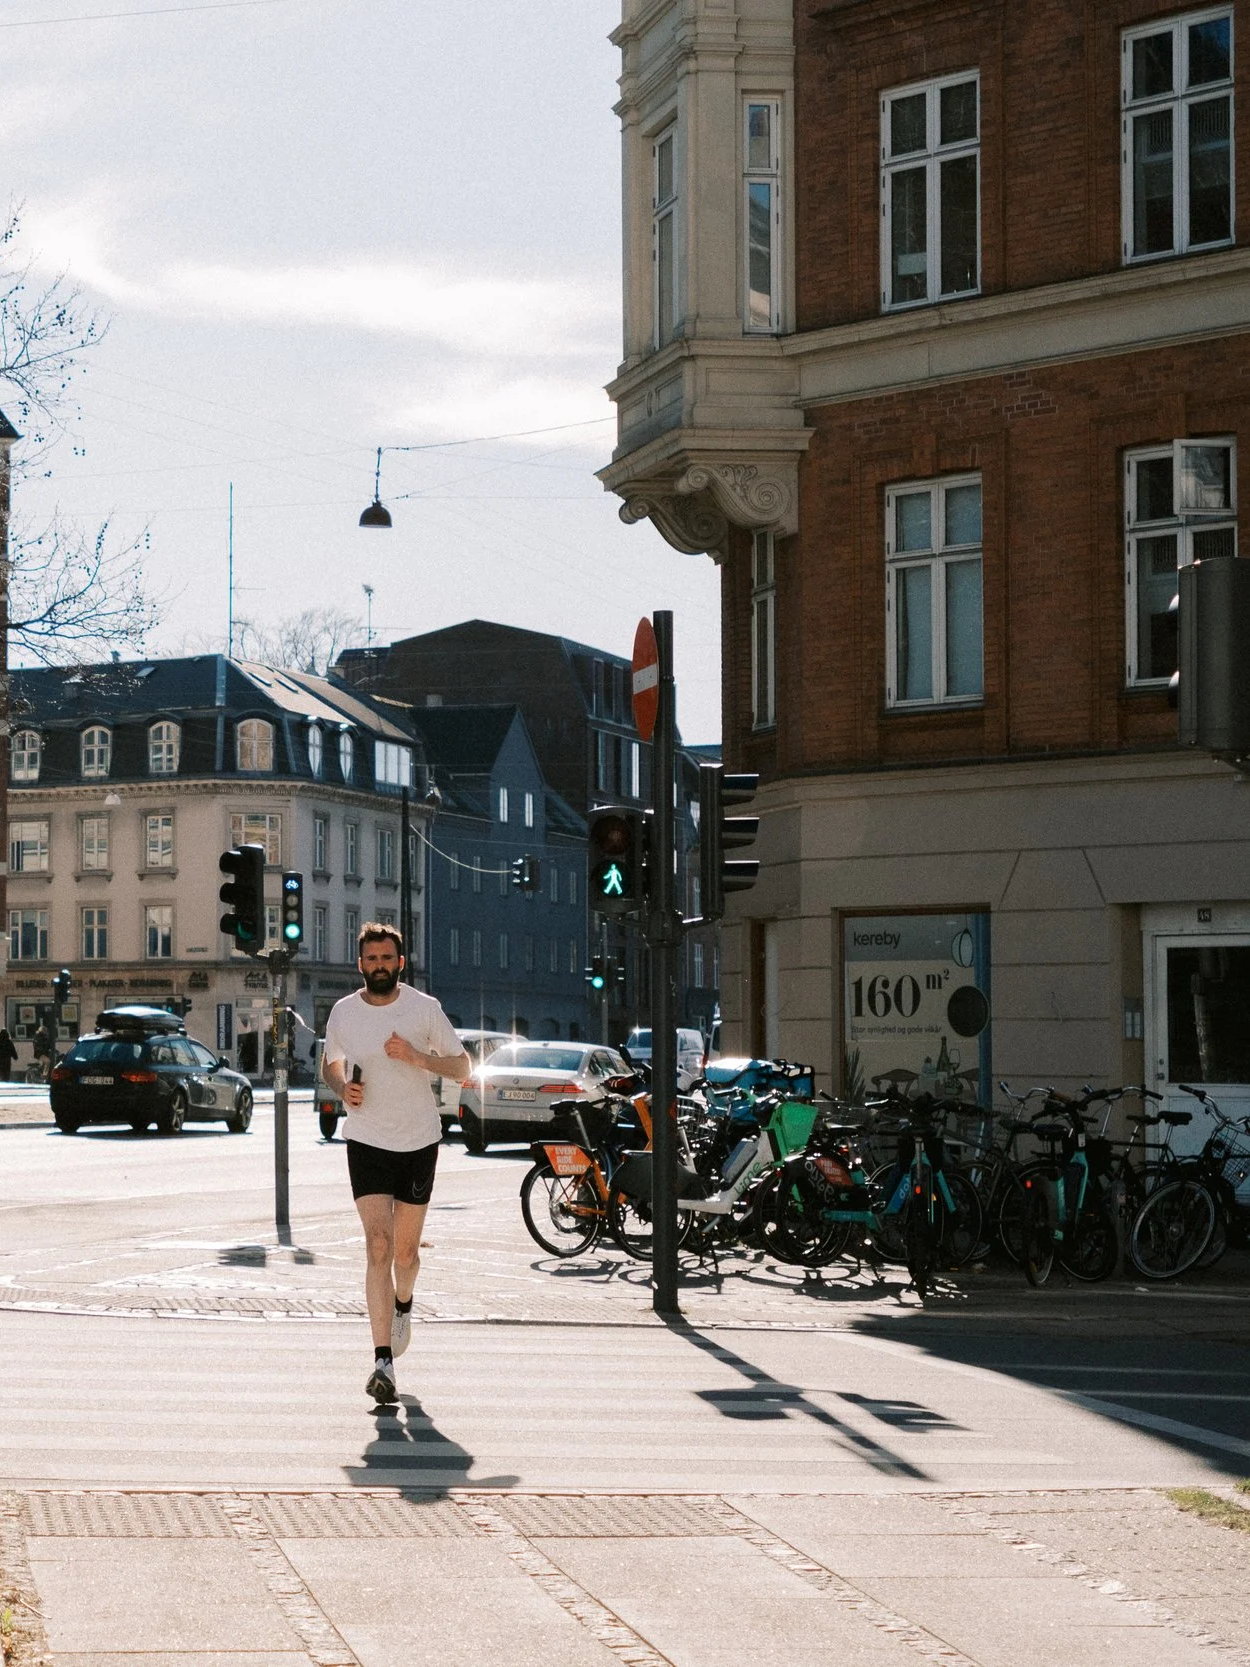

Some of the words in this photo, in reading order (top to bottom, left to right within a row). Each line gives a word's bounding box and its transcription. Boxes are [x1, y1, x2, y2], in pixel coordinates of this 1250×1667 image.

[853, 931, 901, 949] kereby
[89, 979, 124, 988] PLAKATER
[851, 974, 921, 1018] 160
[907, 1026, 923, 1035] gode
[555, 1147, 577, 1156] EVERY
[556, 1155, 573, 1164] RIDE
[558, 1164, 587, 1173] COUNTS
[734, 1162, 762, 1194] Lime
